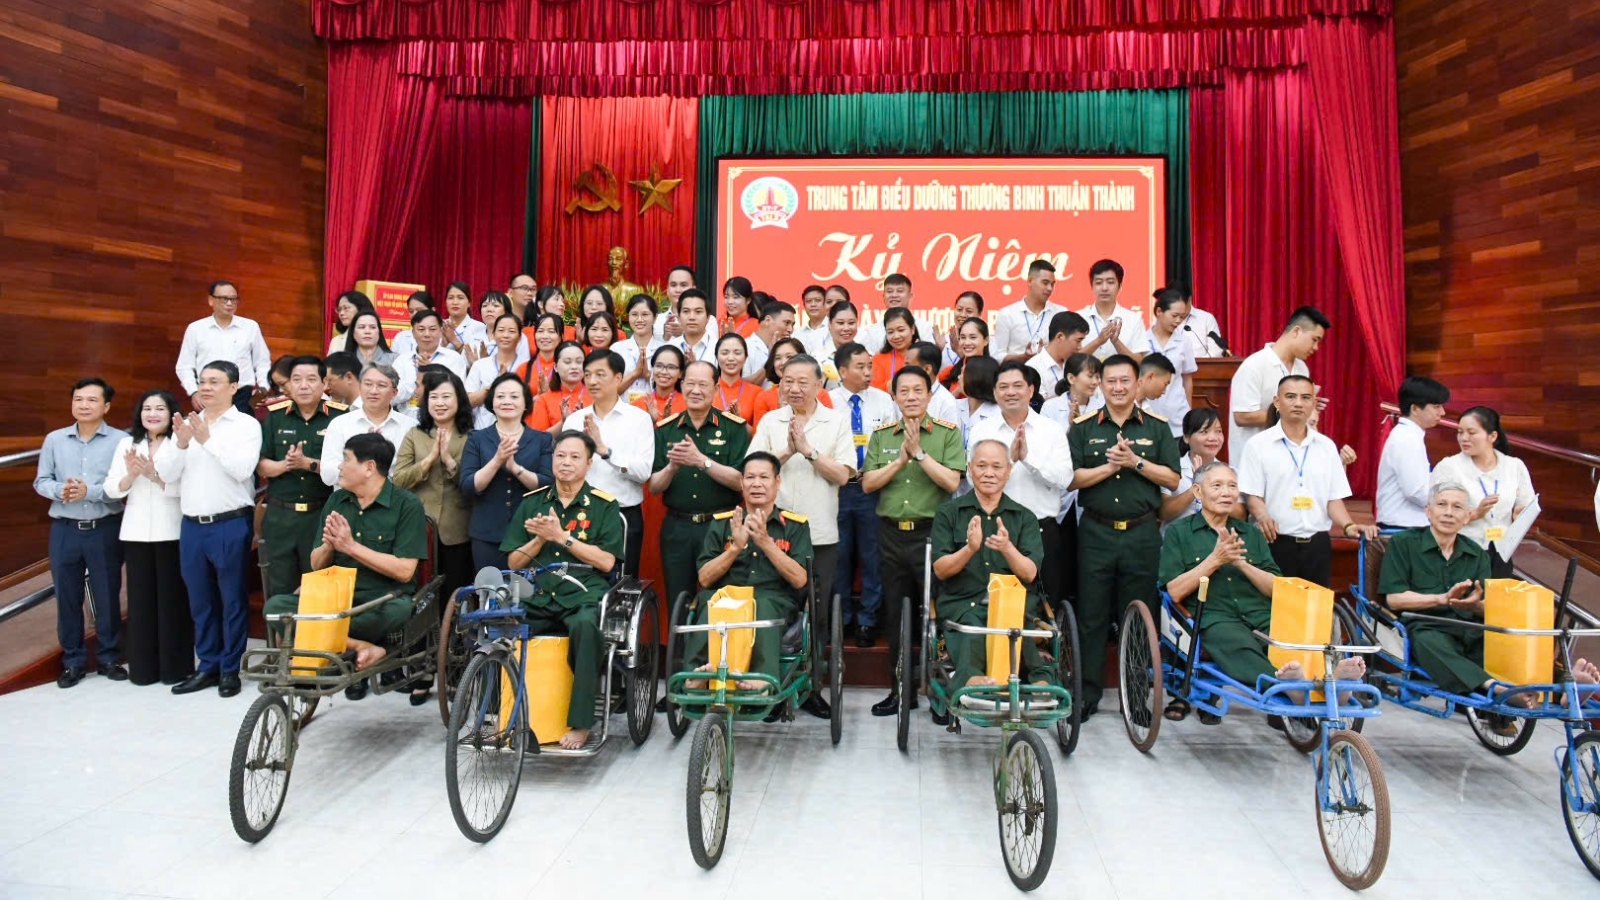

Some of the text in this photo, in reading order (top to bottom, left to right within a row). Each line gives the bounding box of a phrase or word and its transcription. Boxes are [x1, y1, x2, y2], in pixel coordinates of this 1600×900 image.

[806, 185, 848, 211] TRUNG
[850, 180, 879, 211] TÂM
[913, 179, 957, 211] DƯỠNG
[959, 183, 1010, 211] THƯƠNG
[1013, 185, 1045, 211] BINH
[1047, 180, 1090, 217] THUẬN
[1092, 180, 1135, 211] THÀNH
[811, 232, 1074, 295] Kỷ Niệm
